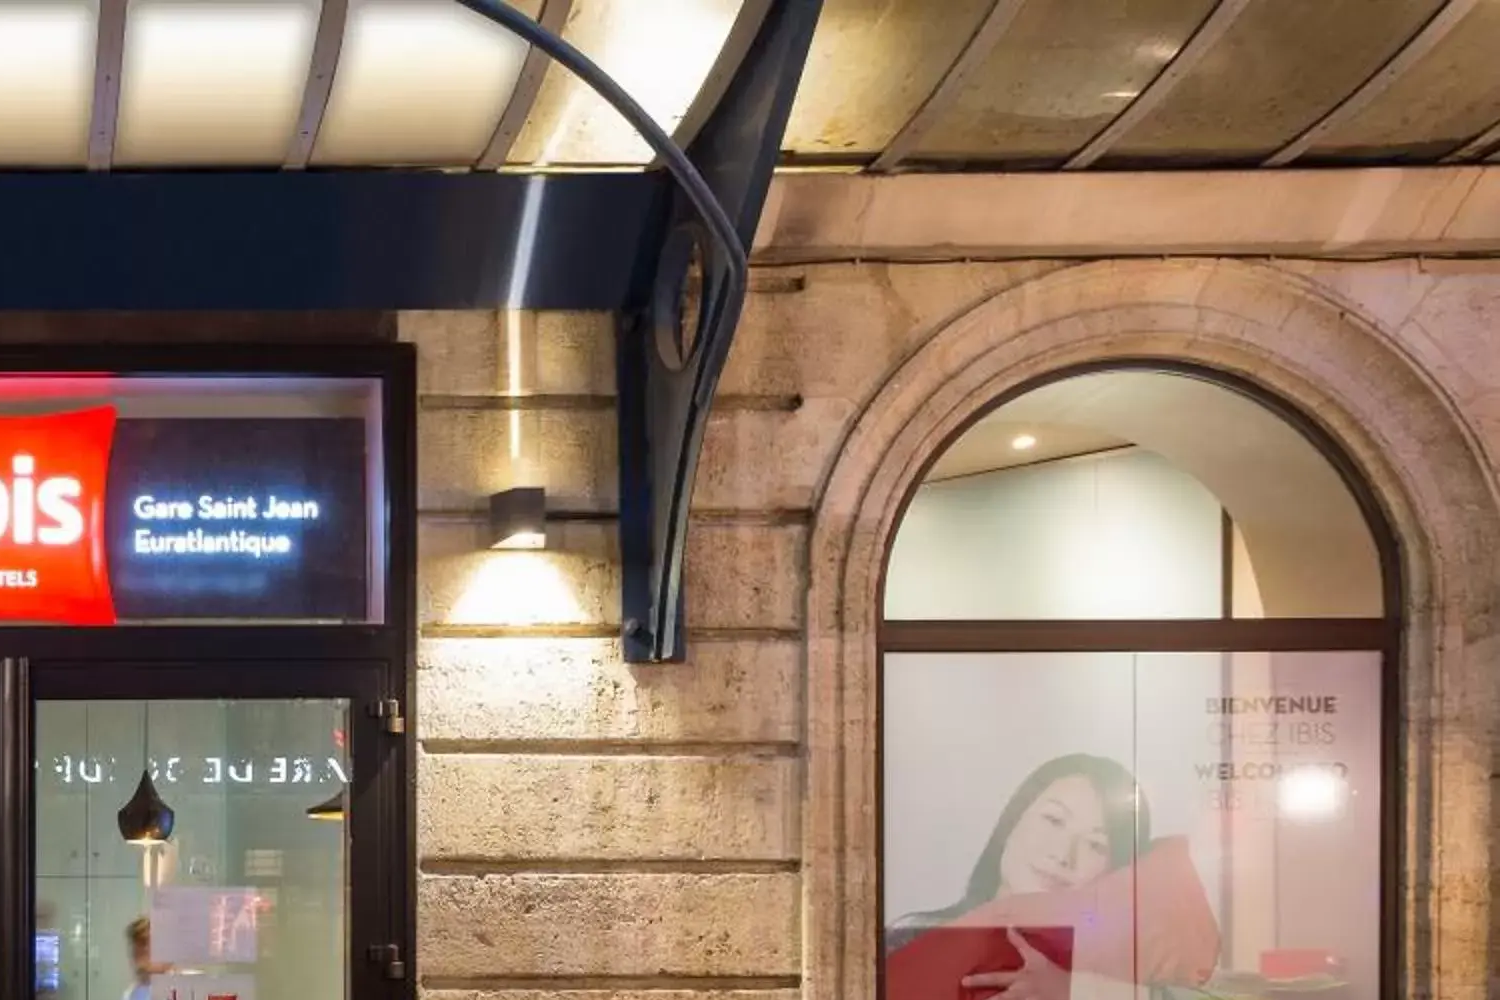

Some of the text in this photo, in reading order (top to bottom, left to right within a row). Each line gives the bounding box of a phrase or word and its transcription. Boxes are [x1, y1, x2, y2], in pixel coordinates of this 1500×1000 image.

[134, 494, 319, 520] Gare Saint Jean
[134, 528, 291, 558] Euratlantique
[1205, 696, 1337, 715] BIENVENUE
[1195, 762, 1306, 782] WELCO
